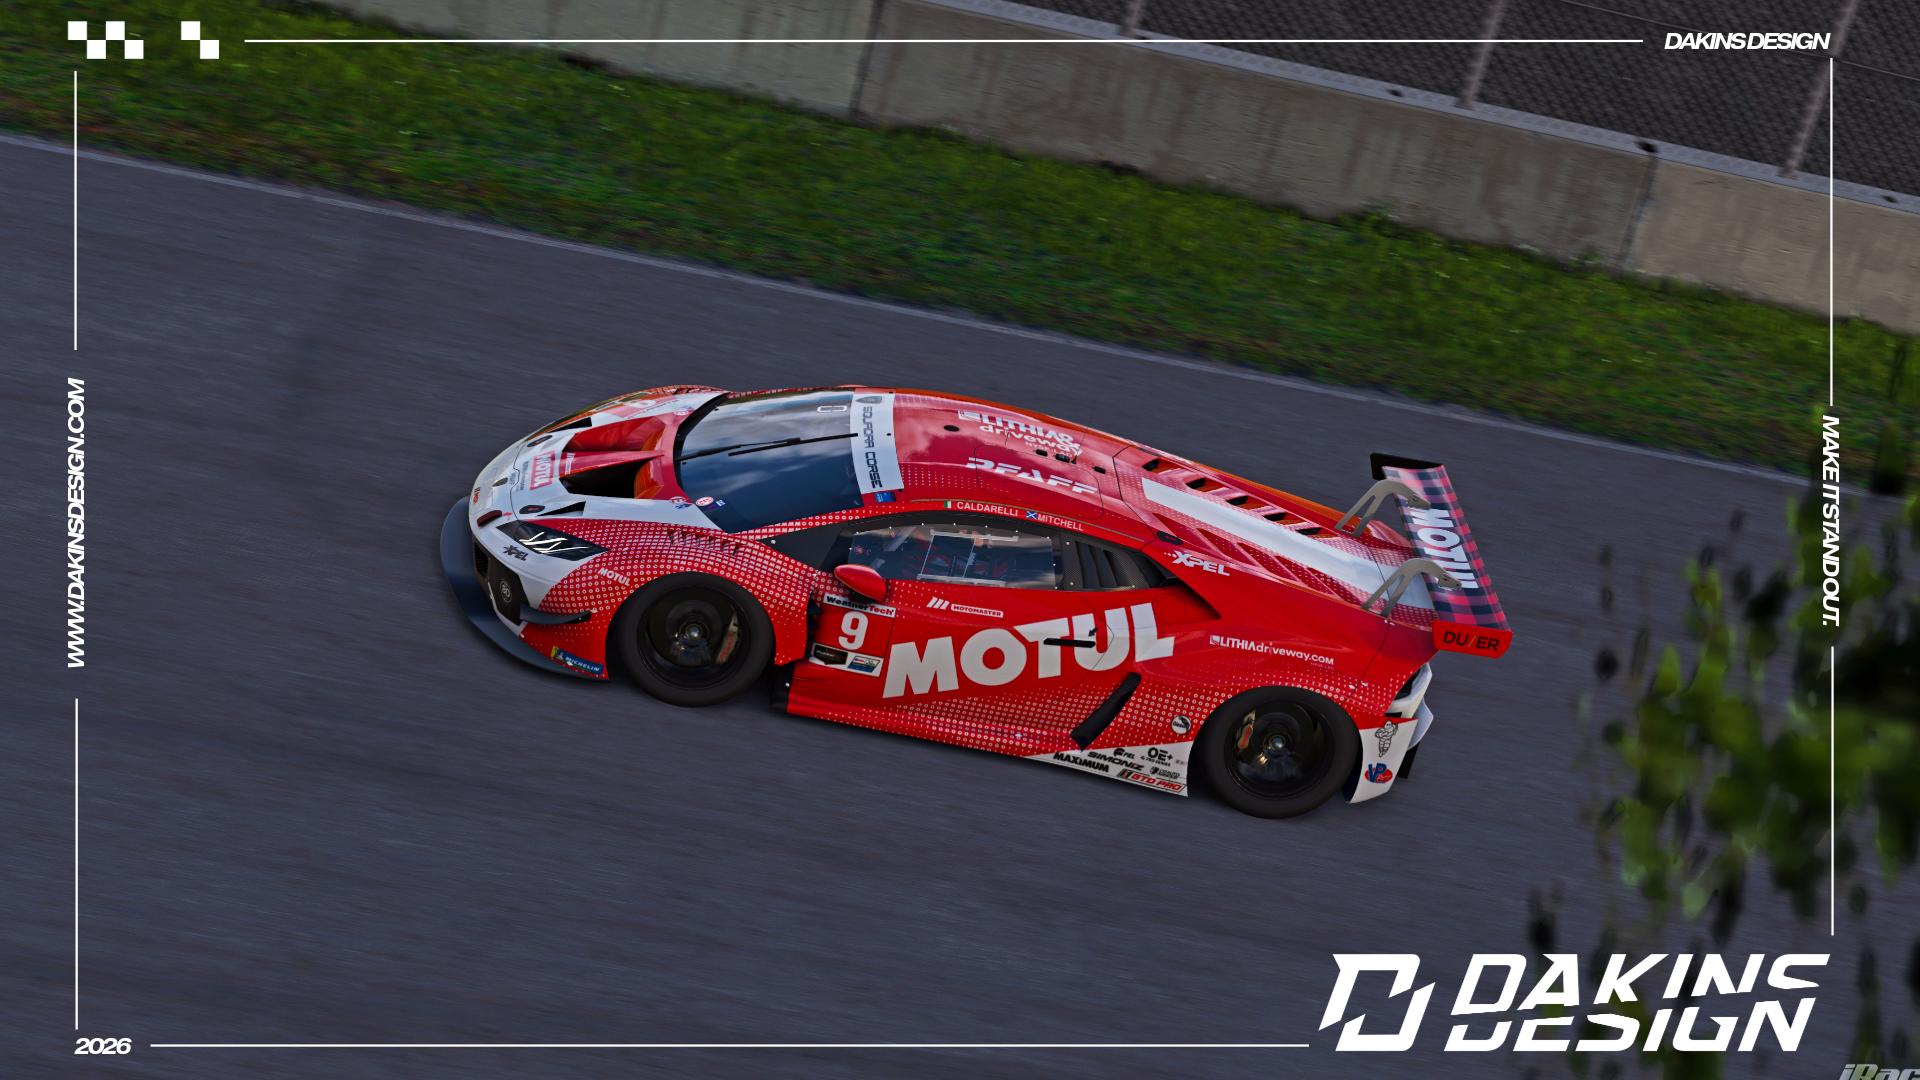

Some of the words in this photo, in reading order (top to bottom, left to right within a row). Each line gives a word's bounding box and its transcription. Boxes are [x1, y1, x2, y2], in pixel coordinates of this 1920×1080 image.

[979, 424, 1083, 456] driveway
[865, 451, 883, 489] CORSE
[965, 456, 1098, 494] PFAFF
[956, 501, 1019, 517] CALDARELLI
[1037, 513, 1085, 531] MITCHELL
[1172, 550, 1230, 577] XPEL
[598, 567, 631, 587] MOTUL
[826, 595, 894, 615] WeatherTech
[953, 604, 1002, 617] MOTOMASTER
[838, 610, 869, 651] 9
[882, 601, 1175, 698] MOTUL
[565, 656, 600, 671] MICHELIN
[1053, 751, 1110, 773] MAXIMUM
[1087, 751, 1145, 771] SIMONIZ
[1131, 772, 1156, 784] GTD
[1156, 779, 1182, 791] PRO
